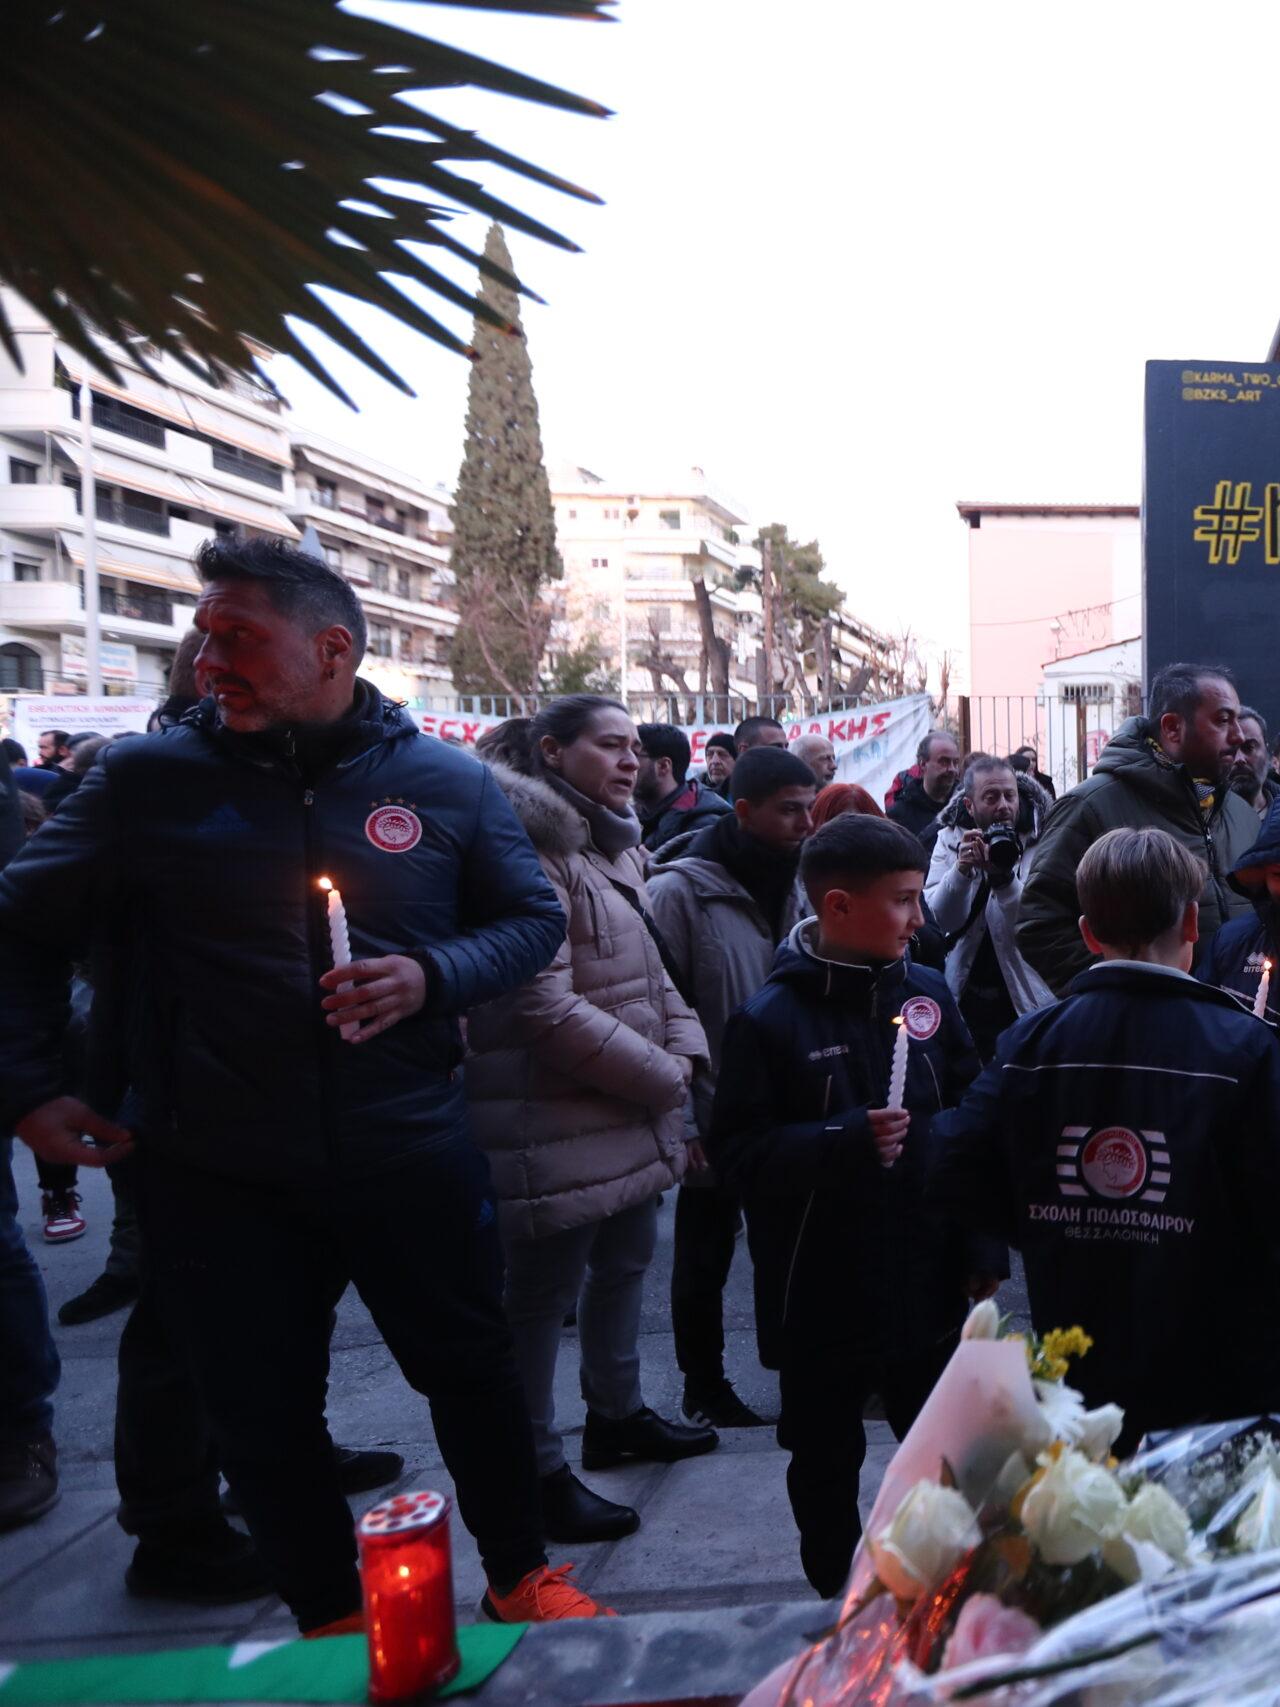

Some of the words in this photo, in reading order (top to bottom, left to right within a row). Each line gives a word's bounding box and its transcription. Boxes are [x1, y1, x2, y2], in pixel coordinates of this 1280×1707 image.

[1028, 1203, 1081, 1223] ΣΧΟΛΗ
[1086, 1206, 1195, 1234] ΠΟΔΟΣΦΑΙΡΟΥ
[1064, 1225, 1160, 1245] ΘΕΣΣΑΛΟΝΙΚΗ
